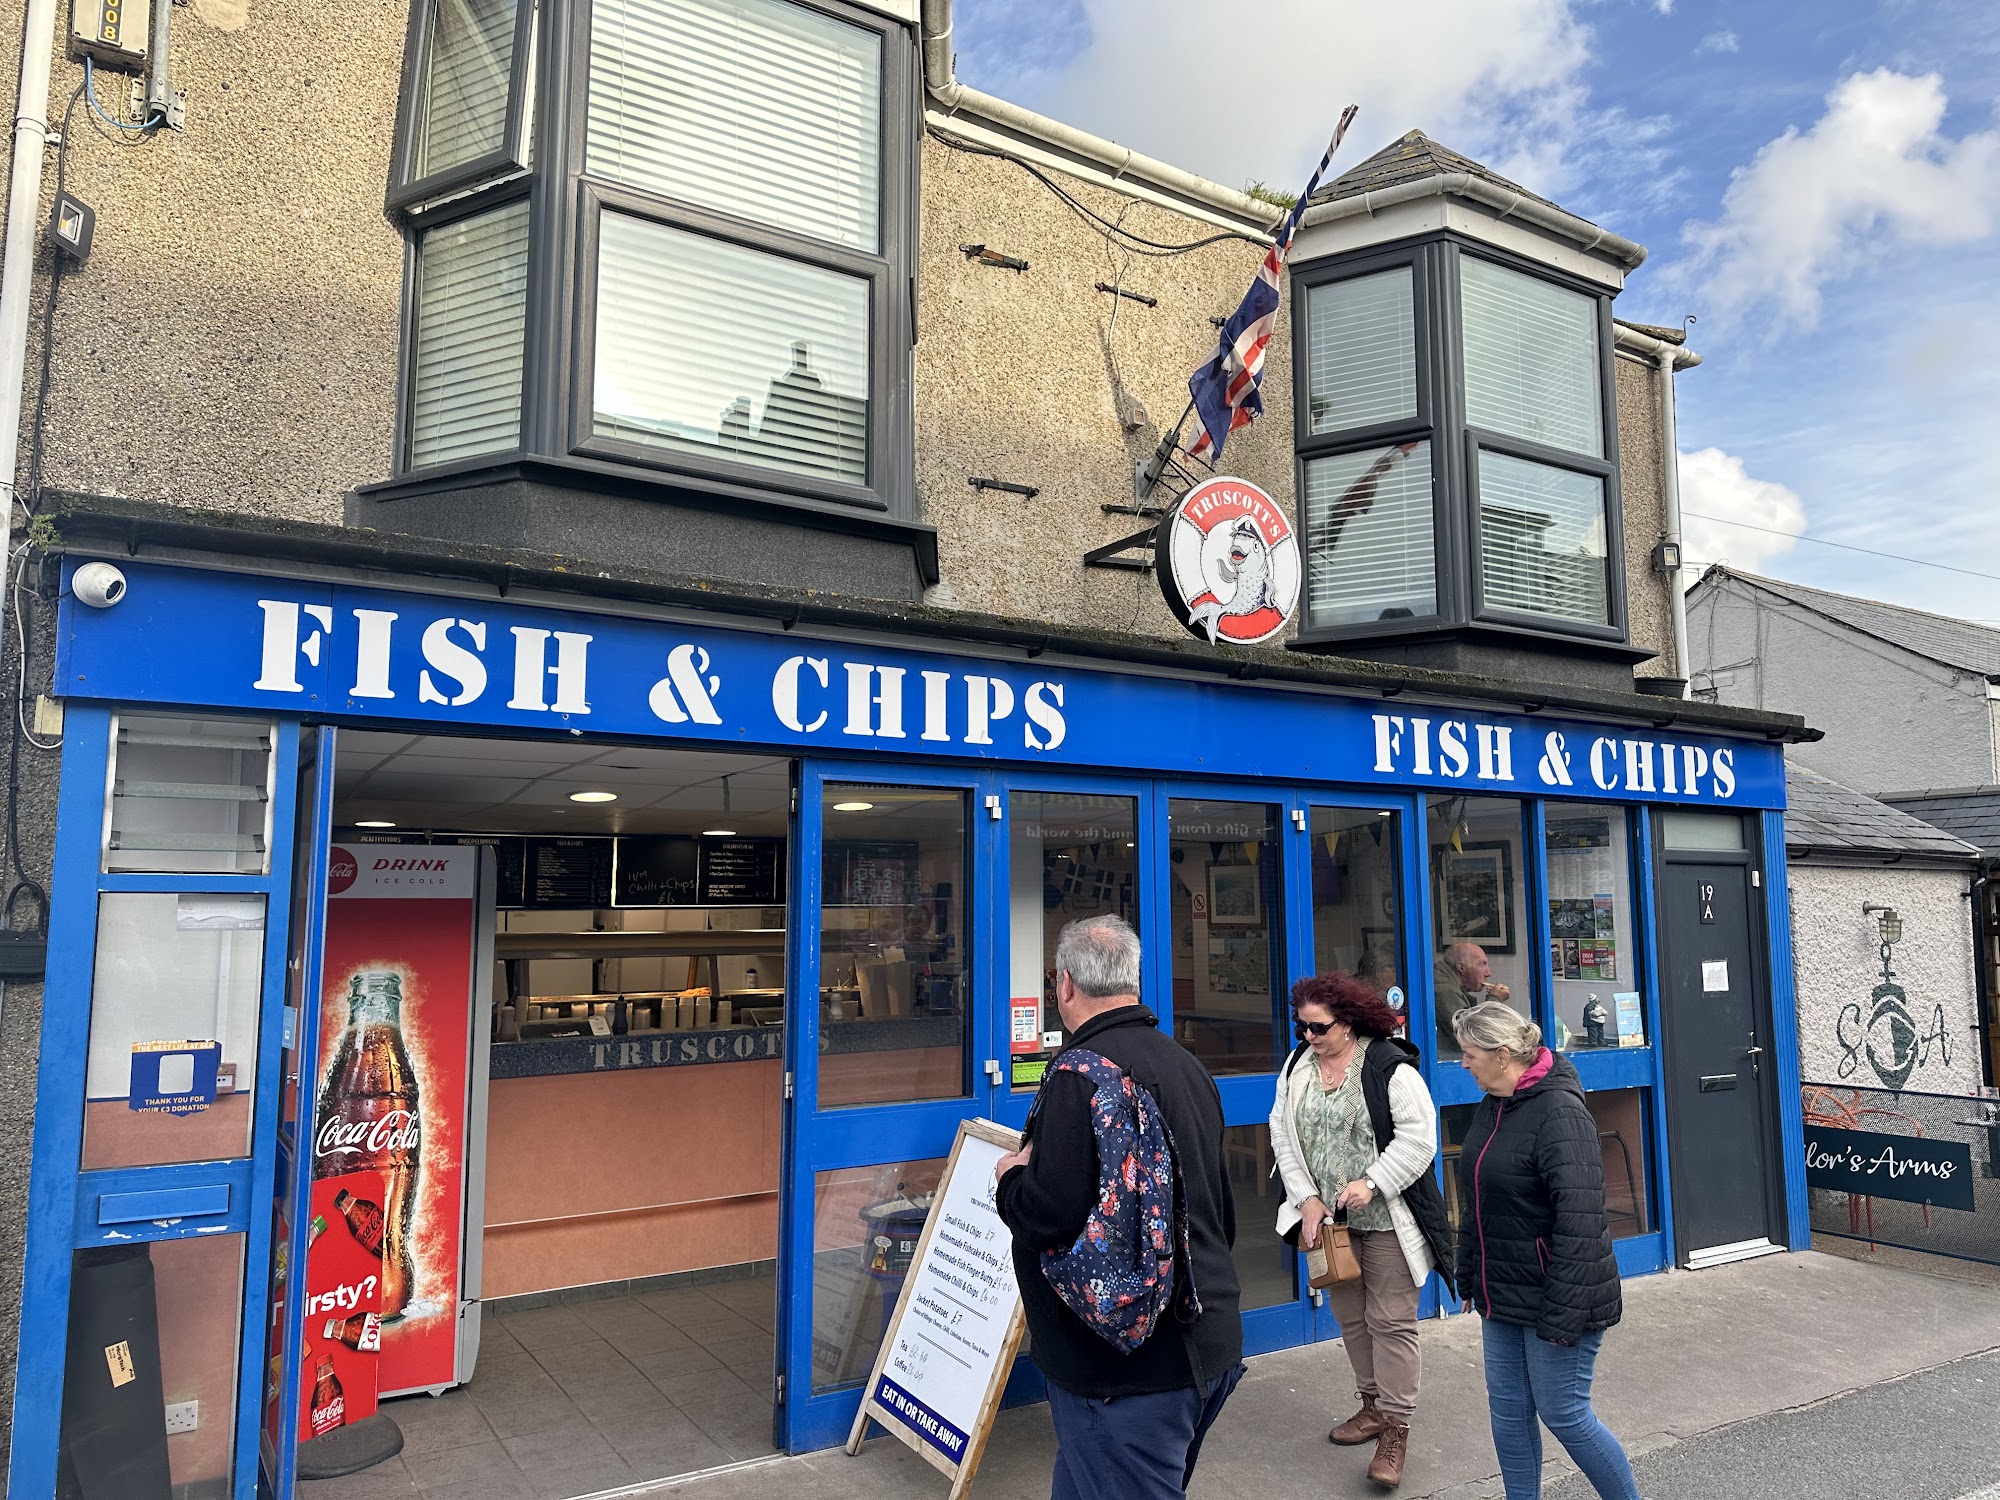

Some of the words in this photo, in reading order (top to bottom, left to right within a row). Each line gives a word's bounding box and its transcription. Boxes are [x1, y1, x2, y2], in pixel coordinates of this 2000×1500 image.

[1191, 490, 1281, 538] TRUSCOTT'S
[253, 600, 594, 715] FISH
[649, 643, 722, 726] &
[772, 655, 1067, 752] CHIPS
[1371, 714, 1515, 783] FISH
[1538, 731, 1574, 787] &
[1589, 736, 1736, 799] CHIPS
[372, 858, 450, 872] DRINK
[657, 890, 676, 905] £6
[666, 877, 695, 894] Chips
[1700, 884, 1715, 901] 19
[1703, 904, 1714, 919] A
[1918, 1003, 1954, 1068] A
[144, 1098, 172, 1106] THANK
[171, 1103, 211, 1113] DONATION
[315, 1109, 420, 1158] Coca-Cola
[1803, 1141, 1867, 1173] lor's
[1866, 1145, 1958, 1179] Arms
[945, 1213, 958, 1226] Small
[956, 1220, 966, 1230] Fish
[965, 1224, 970, 1232] &
[968, 1226, 982, 1240] Chips
[939, 1230, 963, 1248] Homemade
[962, 1242, 981, 1258] Fishcake
[980, 1251, 986, 1260] &
[984, 1253, 999, 1268] Chips
[933, 1246, 957, 1266] Homemade
[956, 1259, 967, 1271] Fish
[965, 1264, 980, 1280] Finger
[978, 1270, 994, 1288] Butty
[927, 1263, 951, 1282] Homemade
[951, 1275, 963, 1288] Chilli
[961, 1281, 967, 1291] &
[965, 1284, 980, 1300] Chips
[304, 1275, 378, 1318] irsty?
[916, 1293, 931, 1307] Jacket
[929, 1300, 949, 1319] Potatoes
[951, 1310, 963, 1328] £7
[900, 1340, 909, 1352] Tea
[894, 1356, 908, 1373] Coffee
[881, 1384, 898, 1405] EAT
[895, 1394, 907, 1412] IN
[904, 1401, 918, 1420] OR
[915, 1409, 939, 1436] TAKE
[935, 1424, 962, 1454] AWAY
